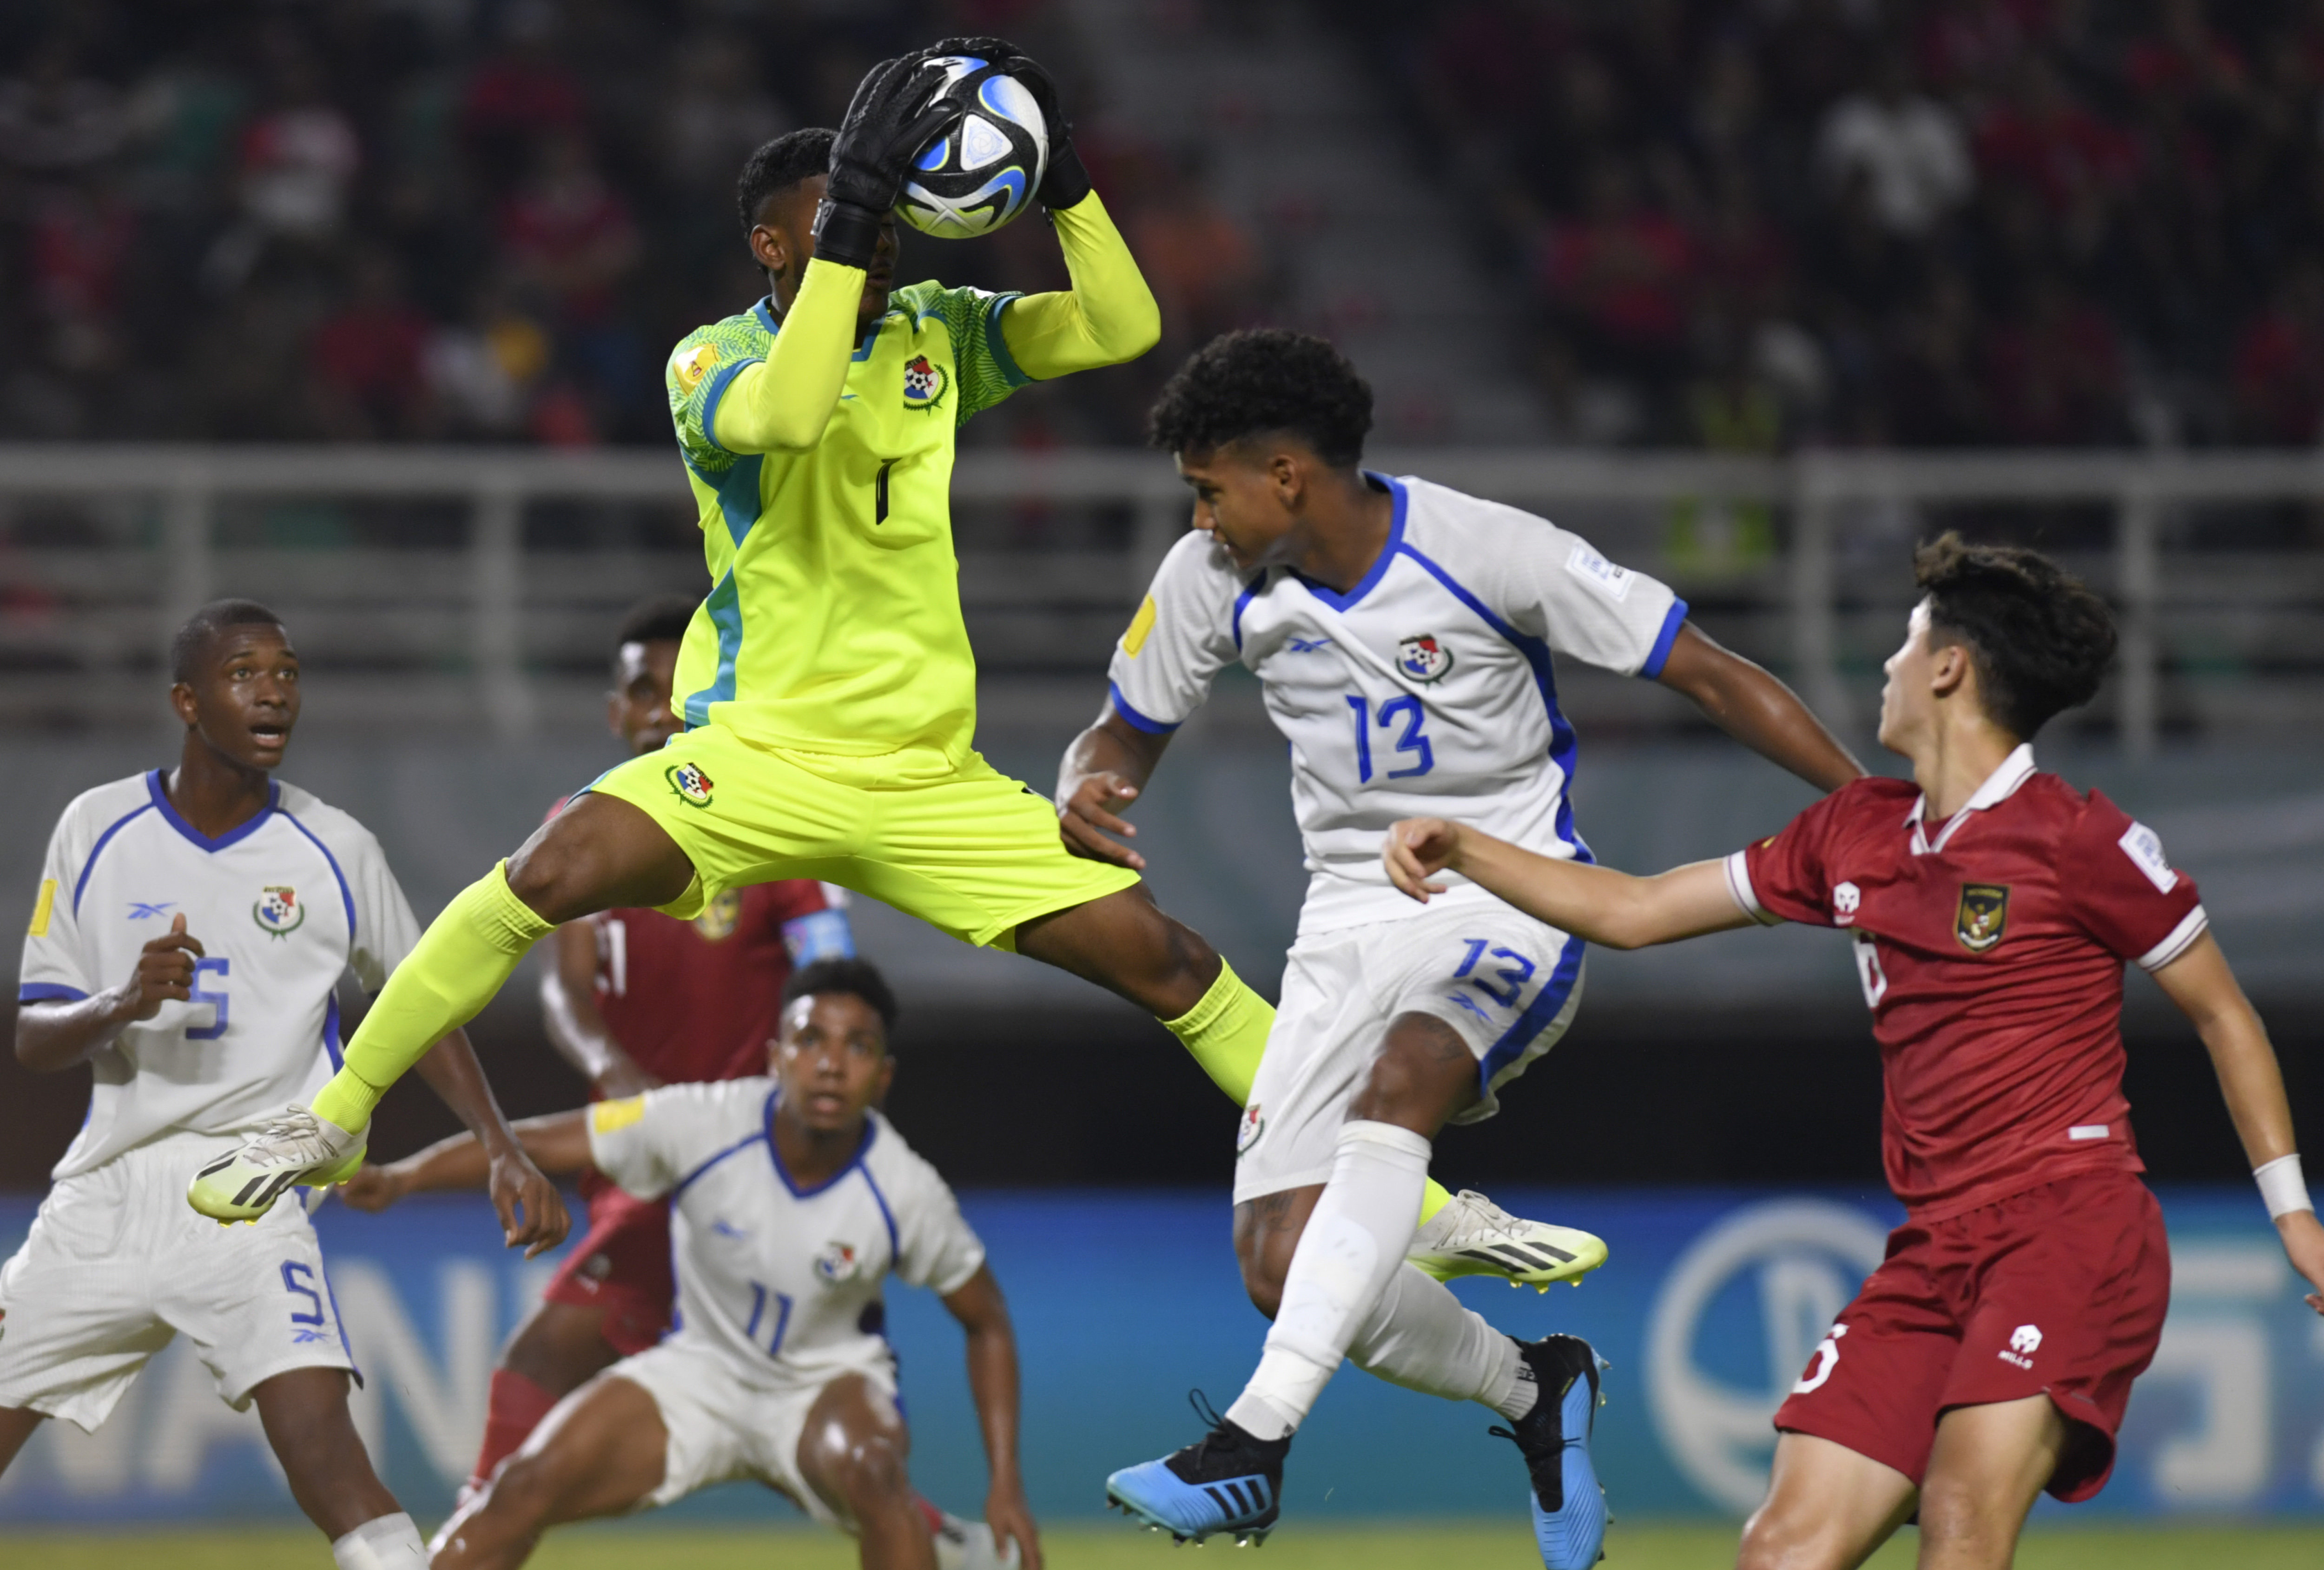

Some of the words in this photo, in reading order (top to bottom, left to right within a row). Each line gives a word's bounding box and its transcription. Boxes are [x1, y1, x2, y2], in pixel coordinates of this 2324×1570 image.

[876, 457, 903, 525] 1
[1346, 694, 1433, 784] 13
[185, 957, 229, 1040] 5
[1453, 938, 1536, 1008] 13
[280, 1259, 324, 1326] 5
[747, 1281, 794, 1358] 11
